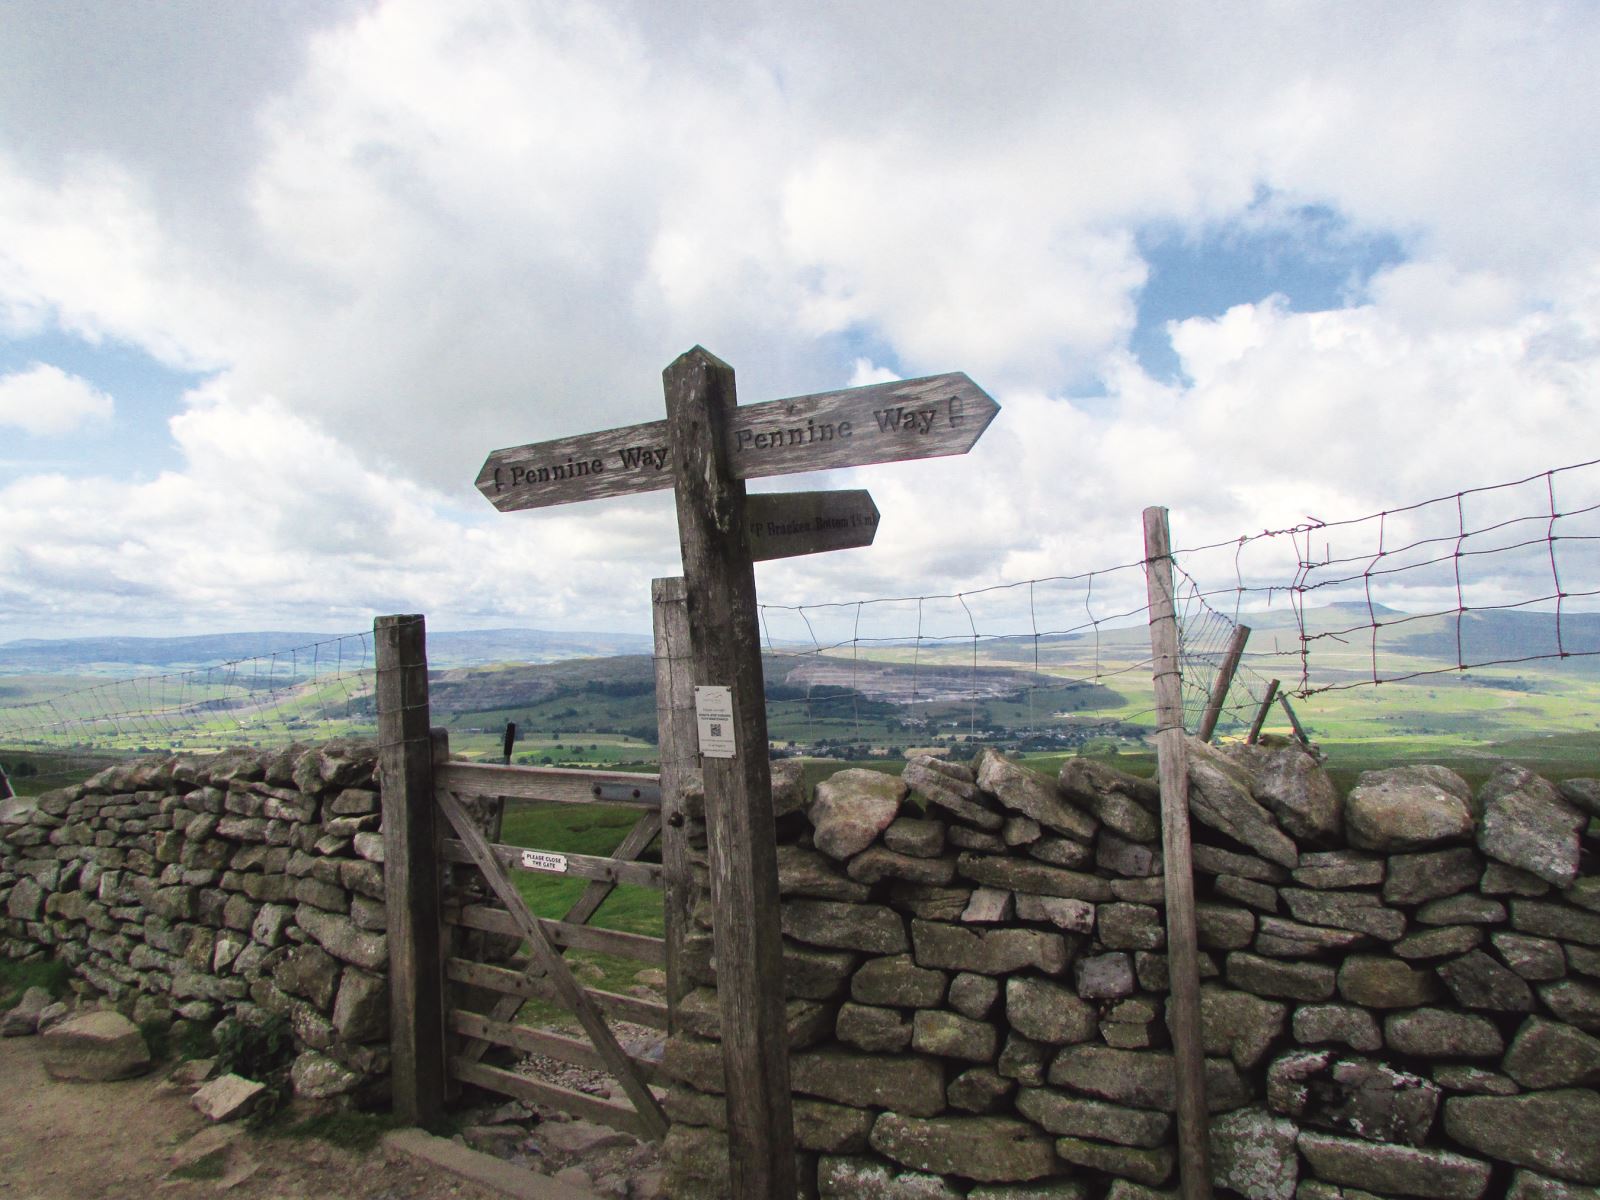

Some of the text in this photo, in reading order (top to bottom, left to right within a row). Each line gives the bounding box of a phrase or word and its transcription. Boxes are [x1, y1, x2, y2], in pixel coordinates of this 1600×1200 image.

[734, 407, 937, 453] Pennine Way
[510, 446, 669, 487] Pennine Way
[815, 516, 849, 532] Bottom
